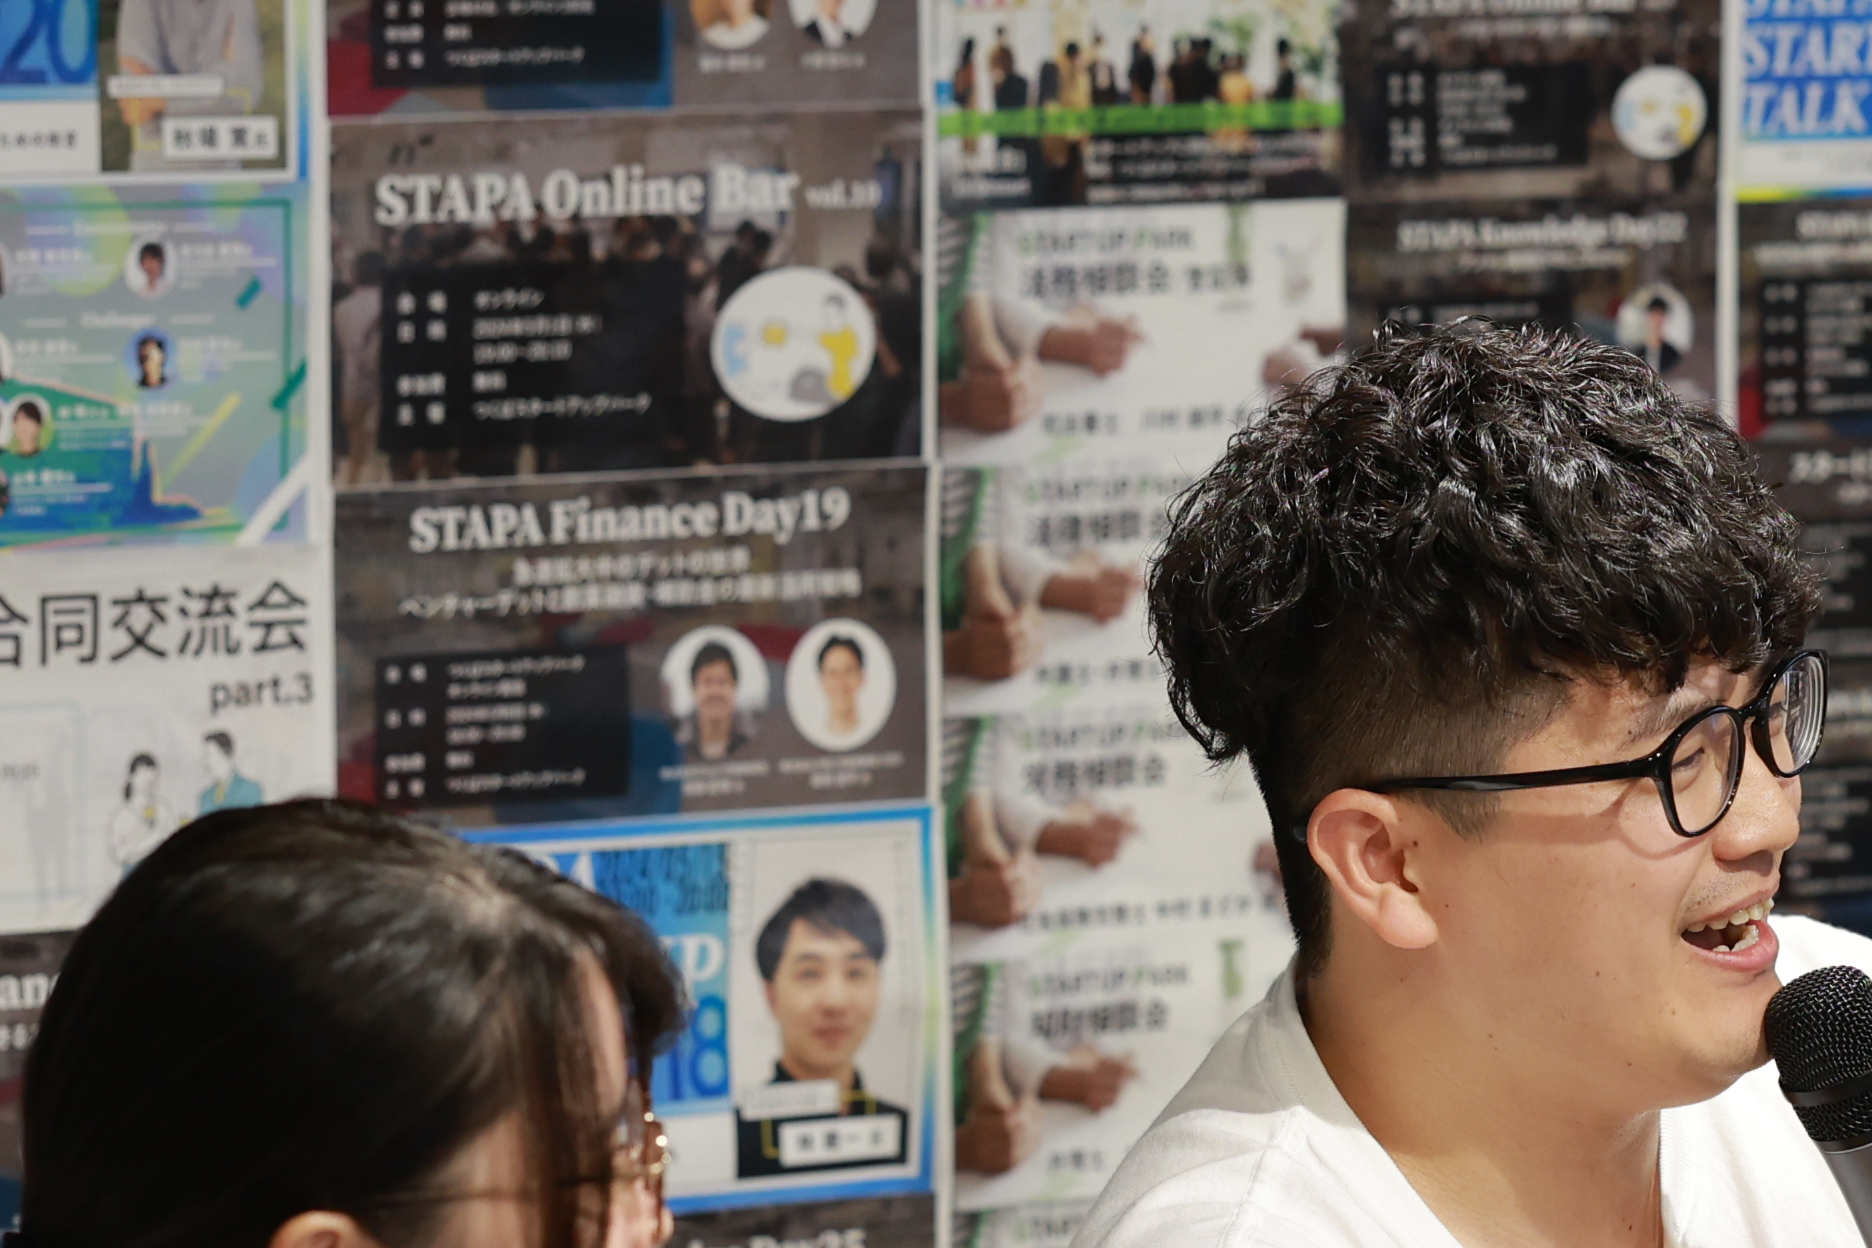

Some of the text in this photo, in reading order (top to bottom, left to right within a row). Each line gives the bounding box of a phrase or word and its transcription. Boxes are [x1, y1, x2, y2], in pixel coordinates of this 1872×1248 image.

[1744, 79, 1872, 137] TALK
[374, 170, 534, 226] STAPA
[540, 164, 705, 220] Online
[713, 160, 799, 212] Bar
[408, 487, 850, 553] STAPA Finance Day19
[210, 671, 313, 714] part.3
